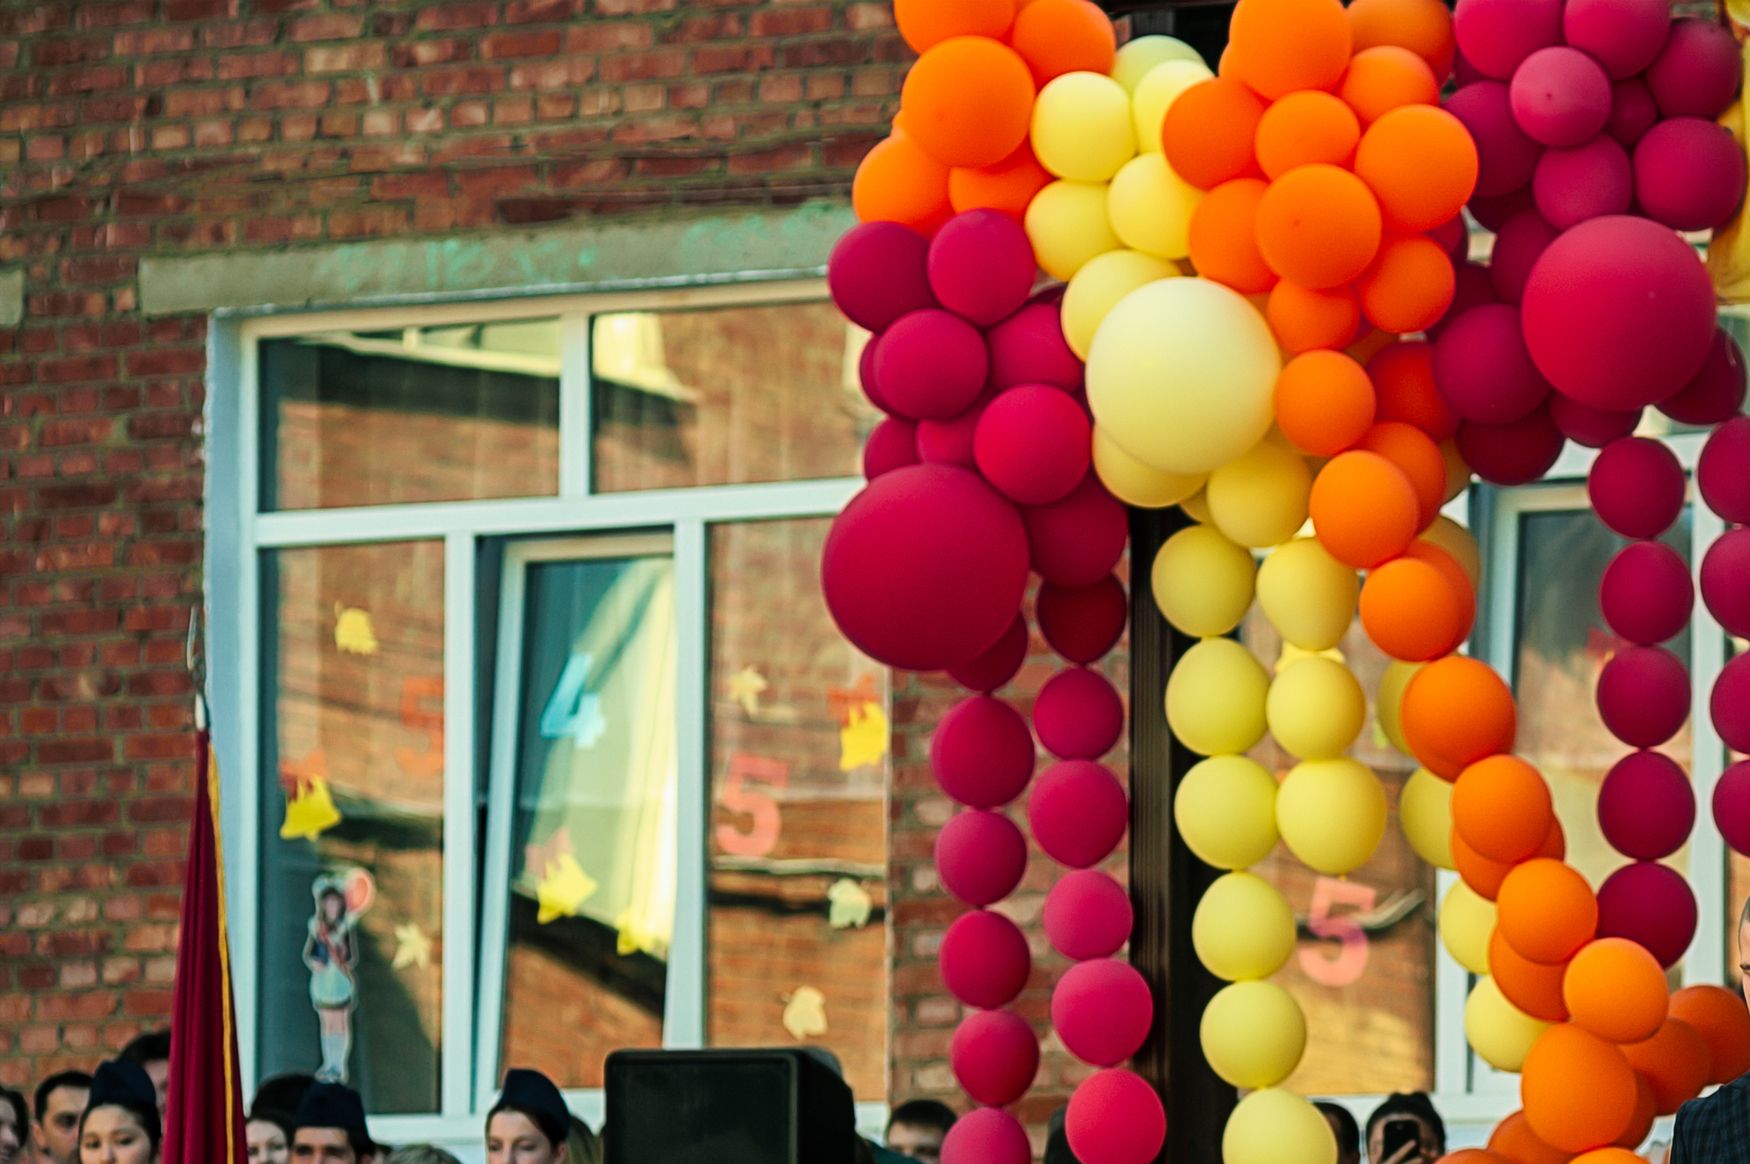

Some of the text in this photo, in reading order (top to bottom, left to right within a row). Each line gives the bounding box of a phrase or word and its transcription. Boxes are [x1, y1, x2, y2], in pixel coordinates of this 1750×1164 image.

[394, 676, 445, 778] 5
[540, 652, 606, 749] 4
[715, 752, 789, 858] 5
[1298, 877, 1376, 988] 5
